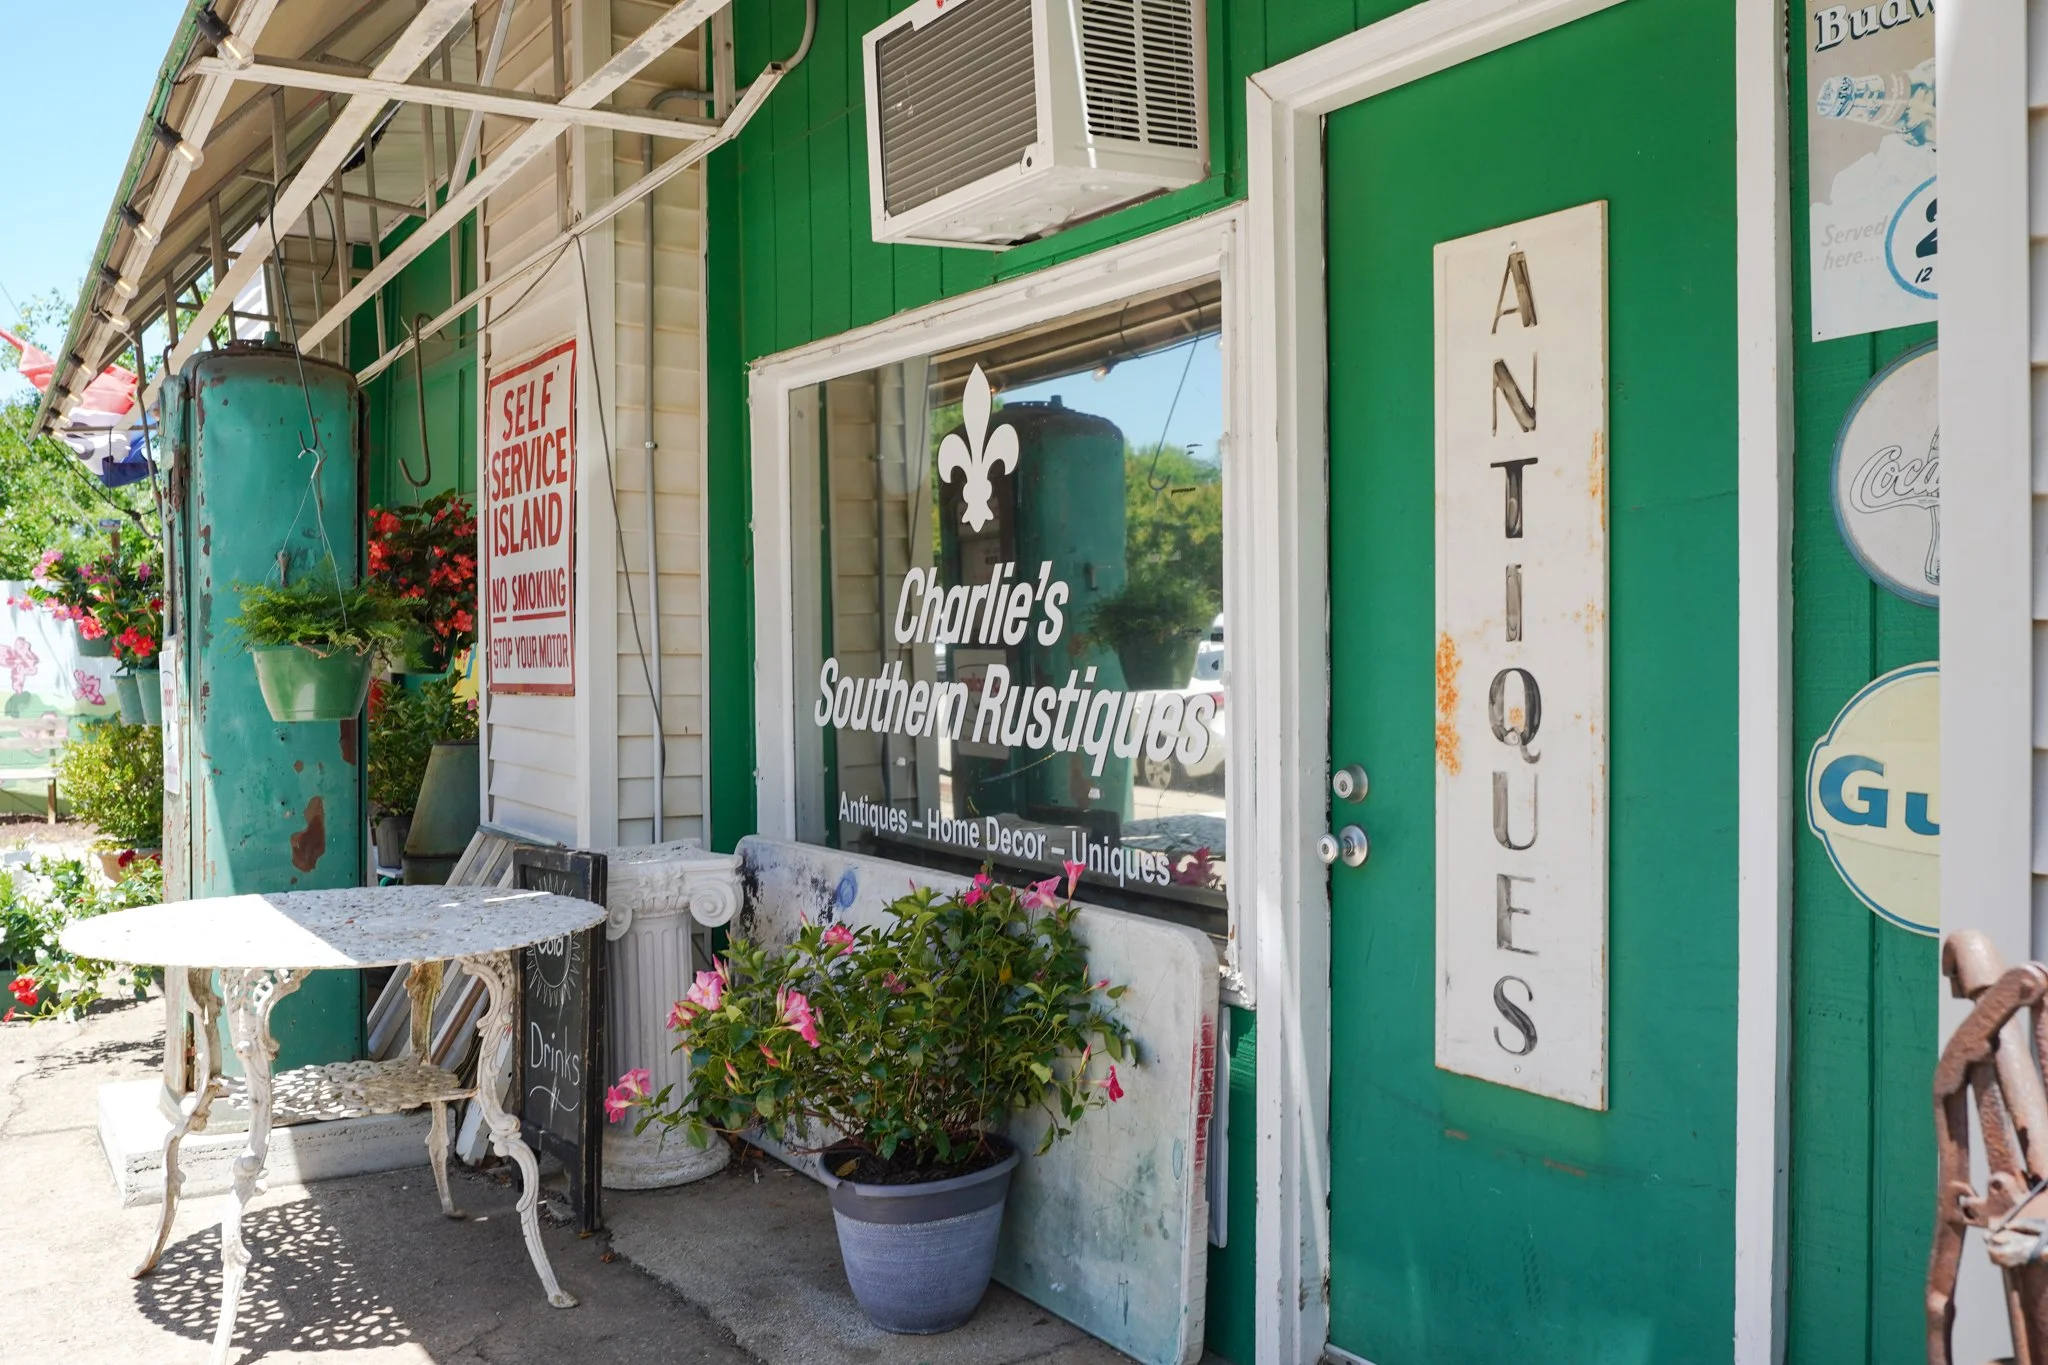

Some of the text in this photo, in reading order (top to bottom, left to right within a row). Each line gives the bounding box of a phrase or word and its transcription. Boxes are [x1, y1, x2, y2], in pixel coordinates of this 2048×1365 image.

[1820, 214, 1889, 247] Served
[1915, 266, 1933, 284] 12
[502, 371, 554, 441] SELF
[491, 427, 568, 502] SERVICE
[493, 492, 562, 557] ISLAND
[492, 567, 566, 614] NO SMOKING
[894, 560, 1069, 647] Charlie's
[493, 633, 569, 669] STOP YOUR MOTOR
[1487, 251, 1542, 1057] ANTIQUES
[814, 657, 1217, 777] Southern Rustiques
[838, 790, 908, 836] Antiques
[927, 807, 980, 849] Home
[986, 816, 1047, 861] Decor
[1071, 830, 1171, 888] Uniques
[531, 1021, 580, 1086] Drinks
